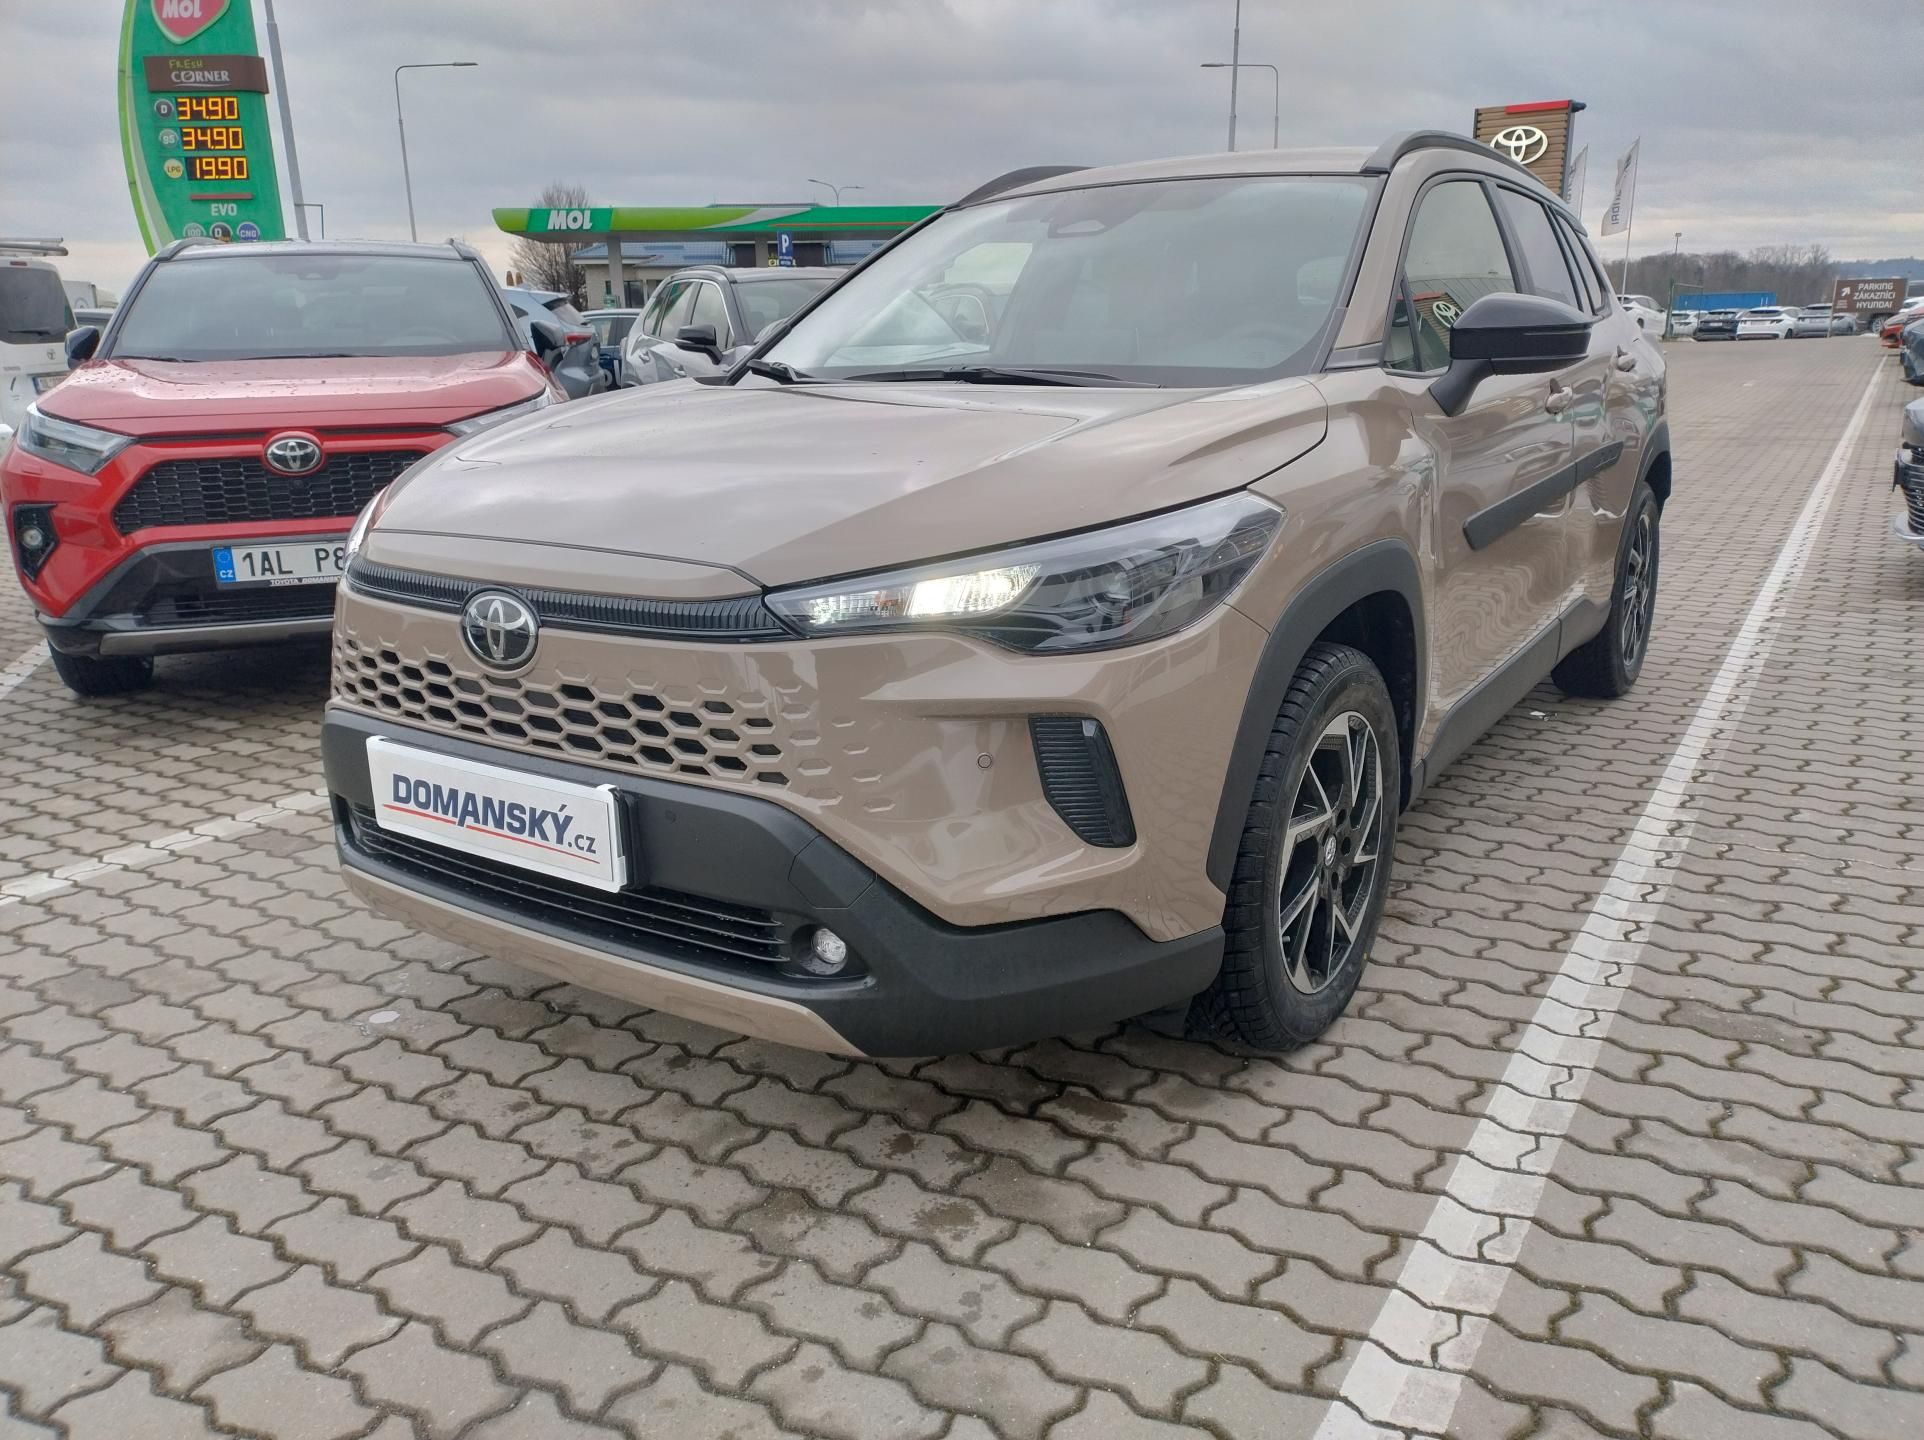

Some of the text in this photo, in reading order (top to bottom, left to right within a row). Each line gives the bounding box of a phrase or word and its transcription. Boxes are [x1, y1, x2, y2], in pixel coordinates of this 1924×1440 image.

[162, 0, 202, 18] MOL
[171, 70, 230, 83] CORNER
[160, 97, 238, 119] D 34.90
[163, 127, 243, 149] 95 34.90
[167, 157, 248, 179] LPG 19.90
[211, 203, 237, 216] EVO
[547, 209, 593, 230] MOL
[214, 228, 222, 238] D
[240, 229, 257, 238] CNG
[781, 234, 790, 253] P
[1858, 282, 1894, 291] PARKING
[1856, 301, 1893, 309] HYUNDAI
[242, 551, 293, 577] 1AL
[219, 570, 234, 578] CZ
[270, 578, 299, 586] TOYOTA
